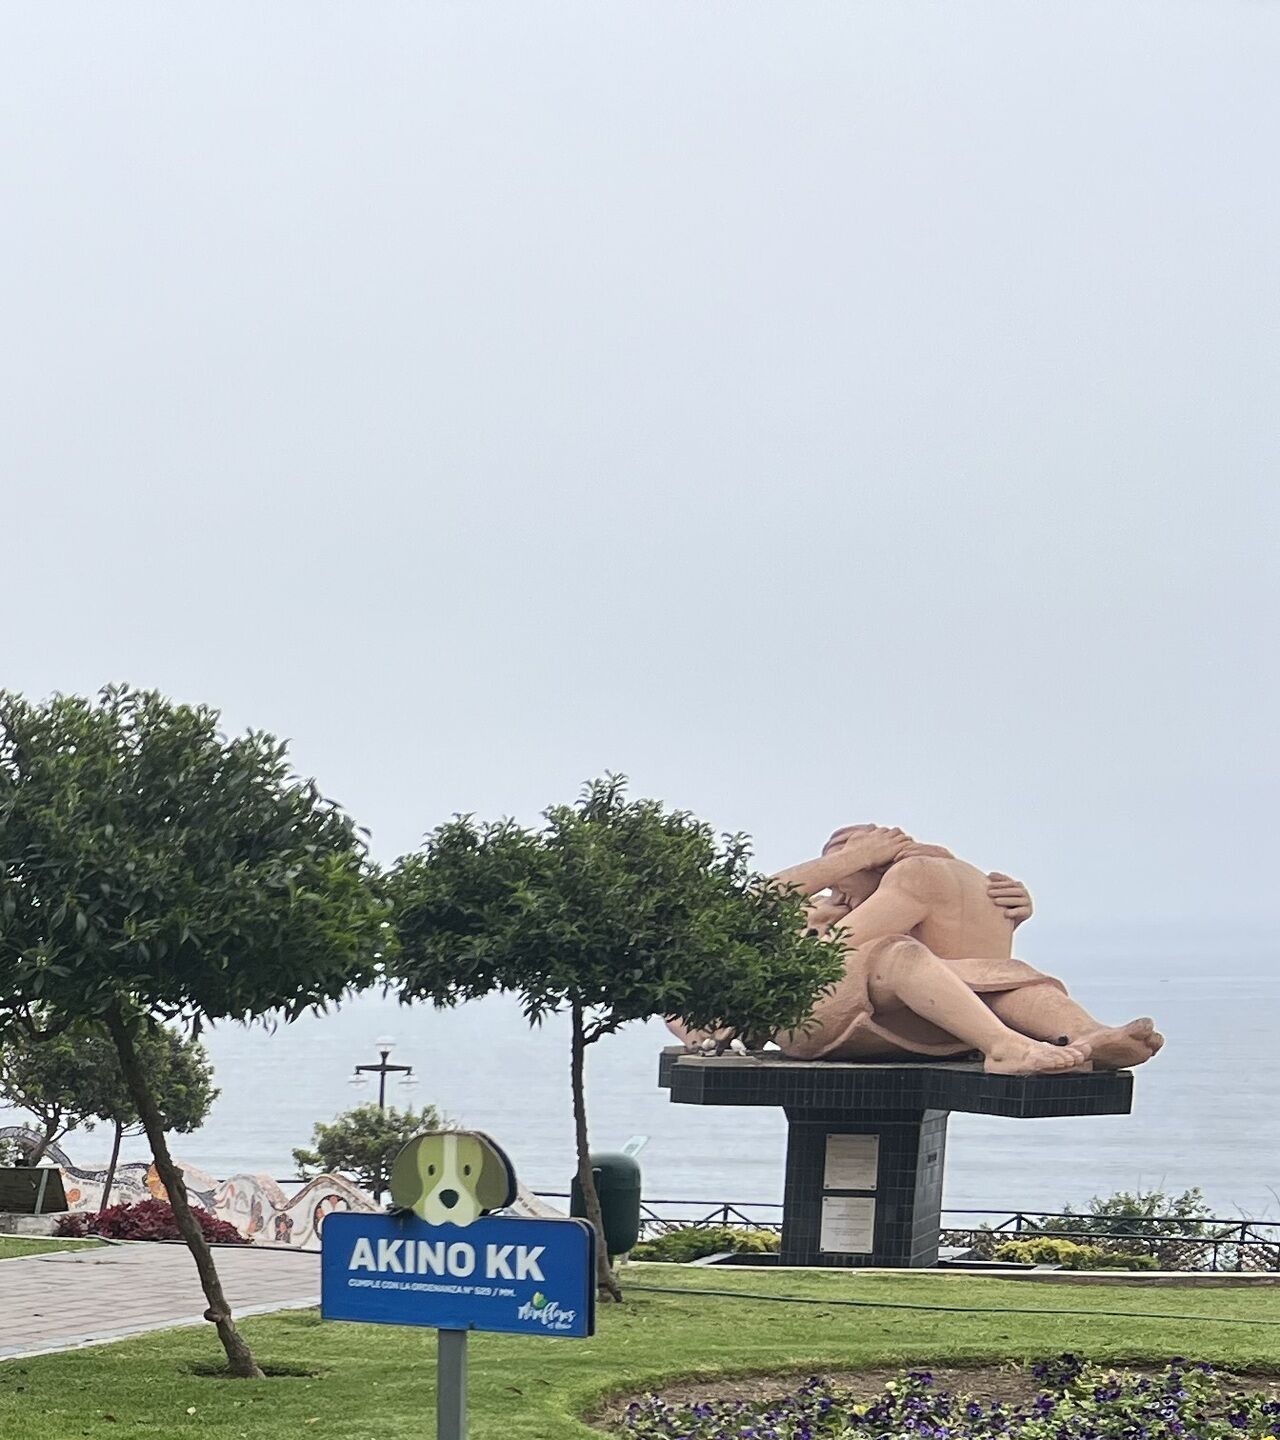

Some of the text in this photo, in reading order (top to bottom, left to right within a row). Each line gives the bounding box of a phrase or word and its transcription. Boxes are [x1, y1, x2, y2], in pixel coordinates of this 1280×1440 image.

[348, 1237, 546, 1281] AKINO KK
[347, 1278, 381, 1289] CUMPLE
[381, 1280, 400, 1290] CON
[399, 1282, 411, 1291] LA
[411, 1282, 463, 1294] ORDENANZA
